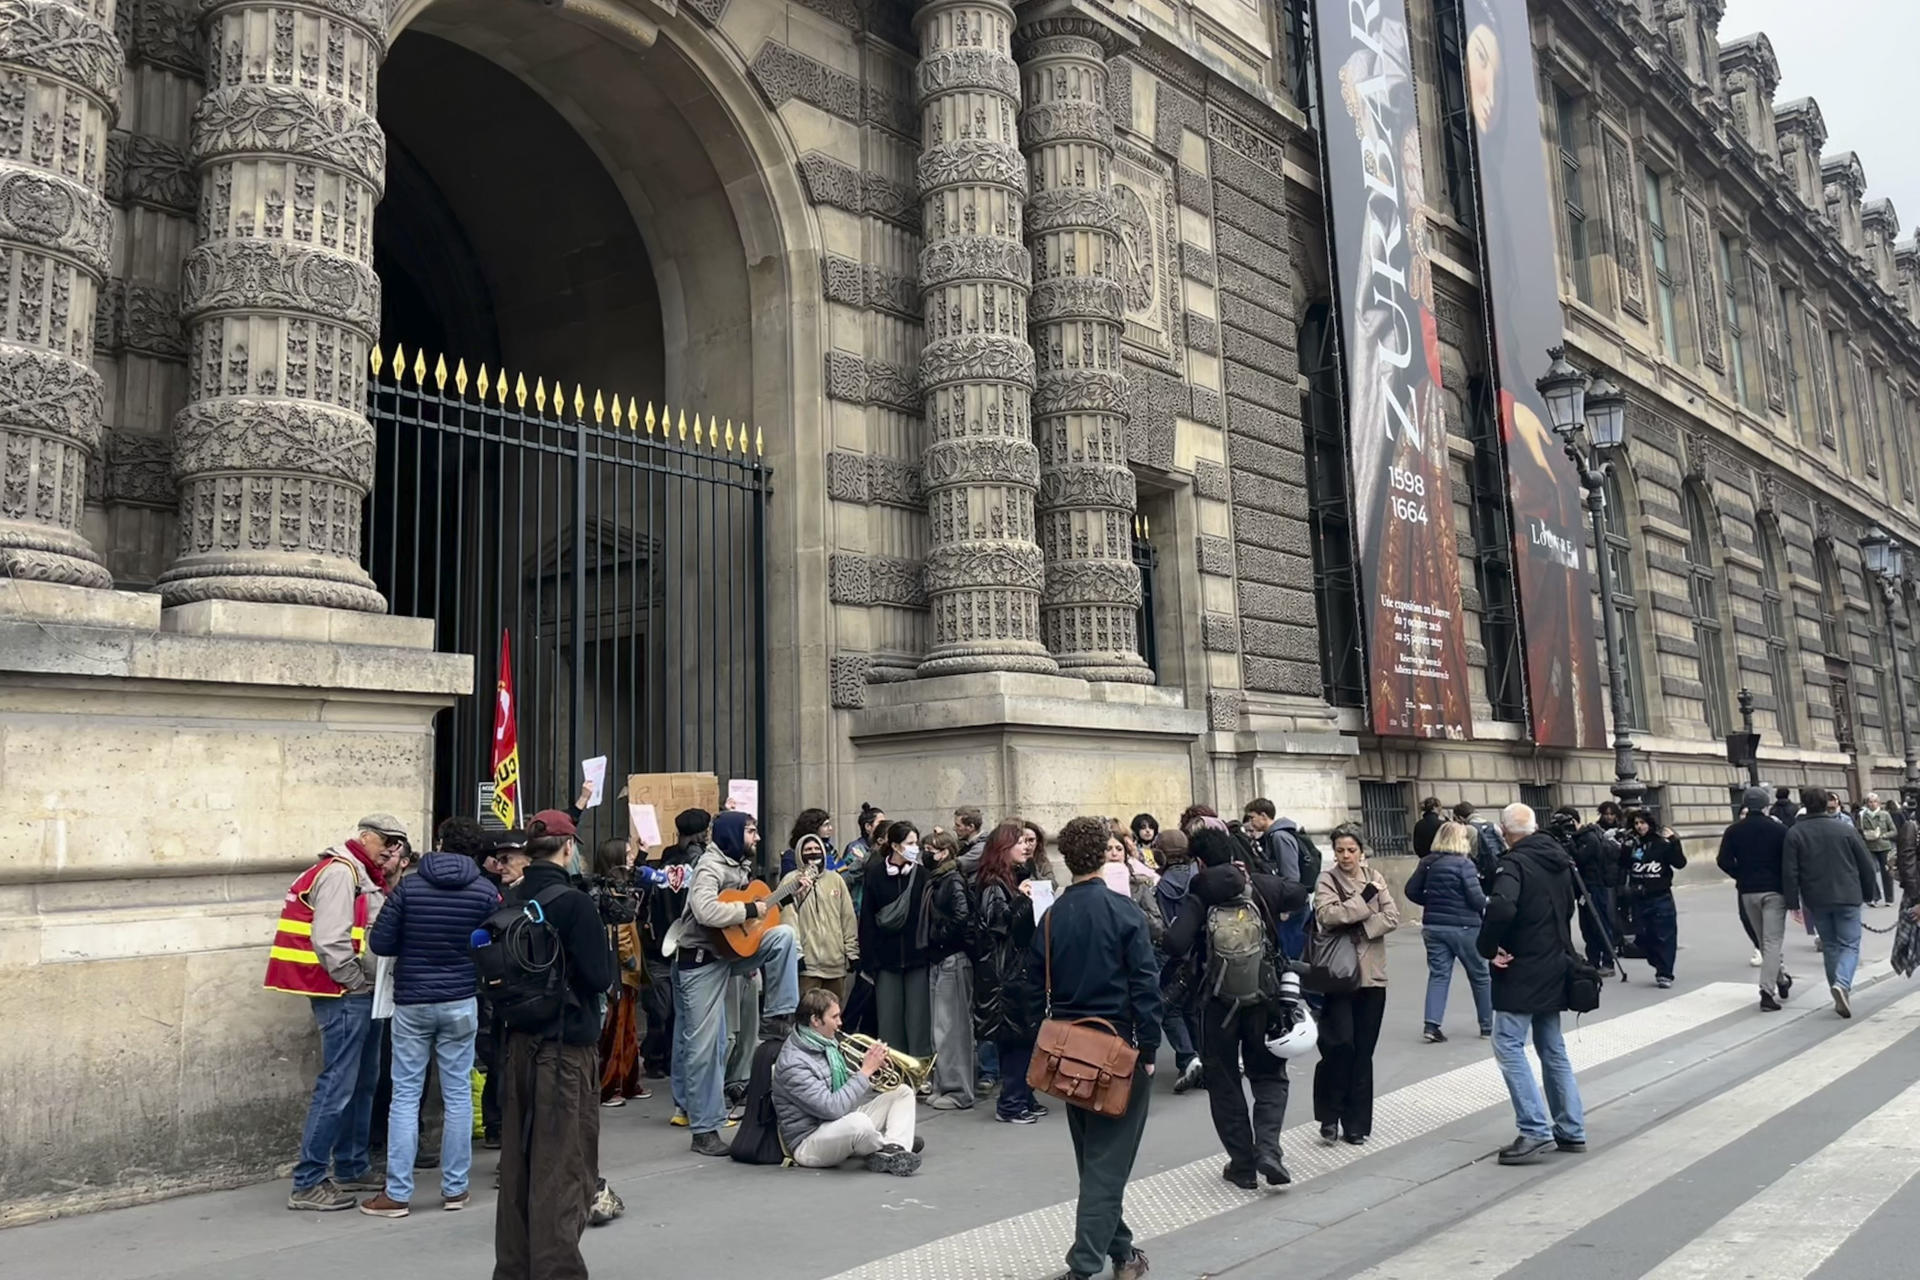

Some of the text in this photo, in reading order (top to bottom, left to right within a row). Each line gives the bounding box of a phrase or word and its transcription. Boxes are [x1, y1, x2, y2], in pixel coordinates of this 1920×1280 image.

[1388, 466, 1425, 496] 1598
[1391, 495, 1428, 526] 1664
[1381, 594, 1394, 606] Une
[1394, 612, 1402, 625] du
[1633, 861, 1662, 872] arte
